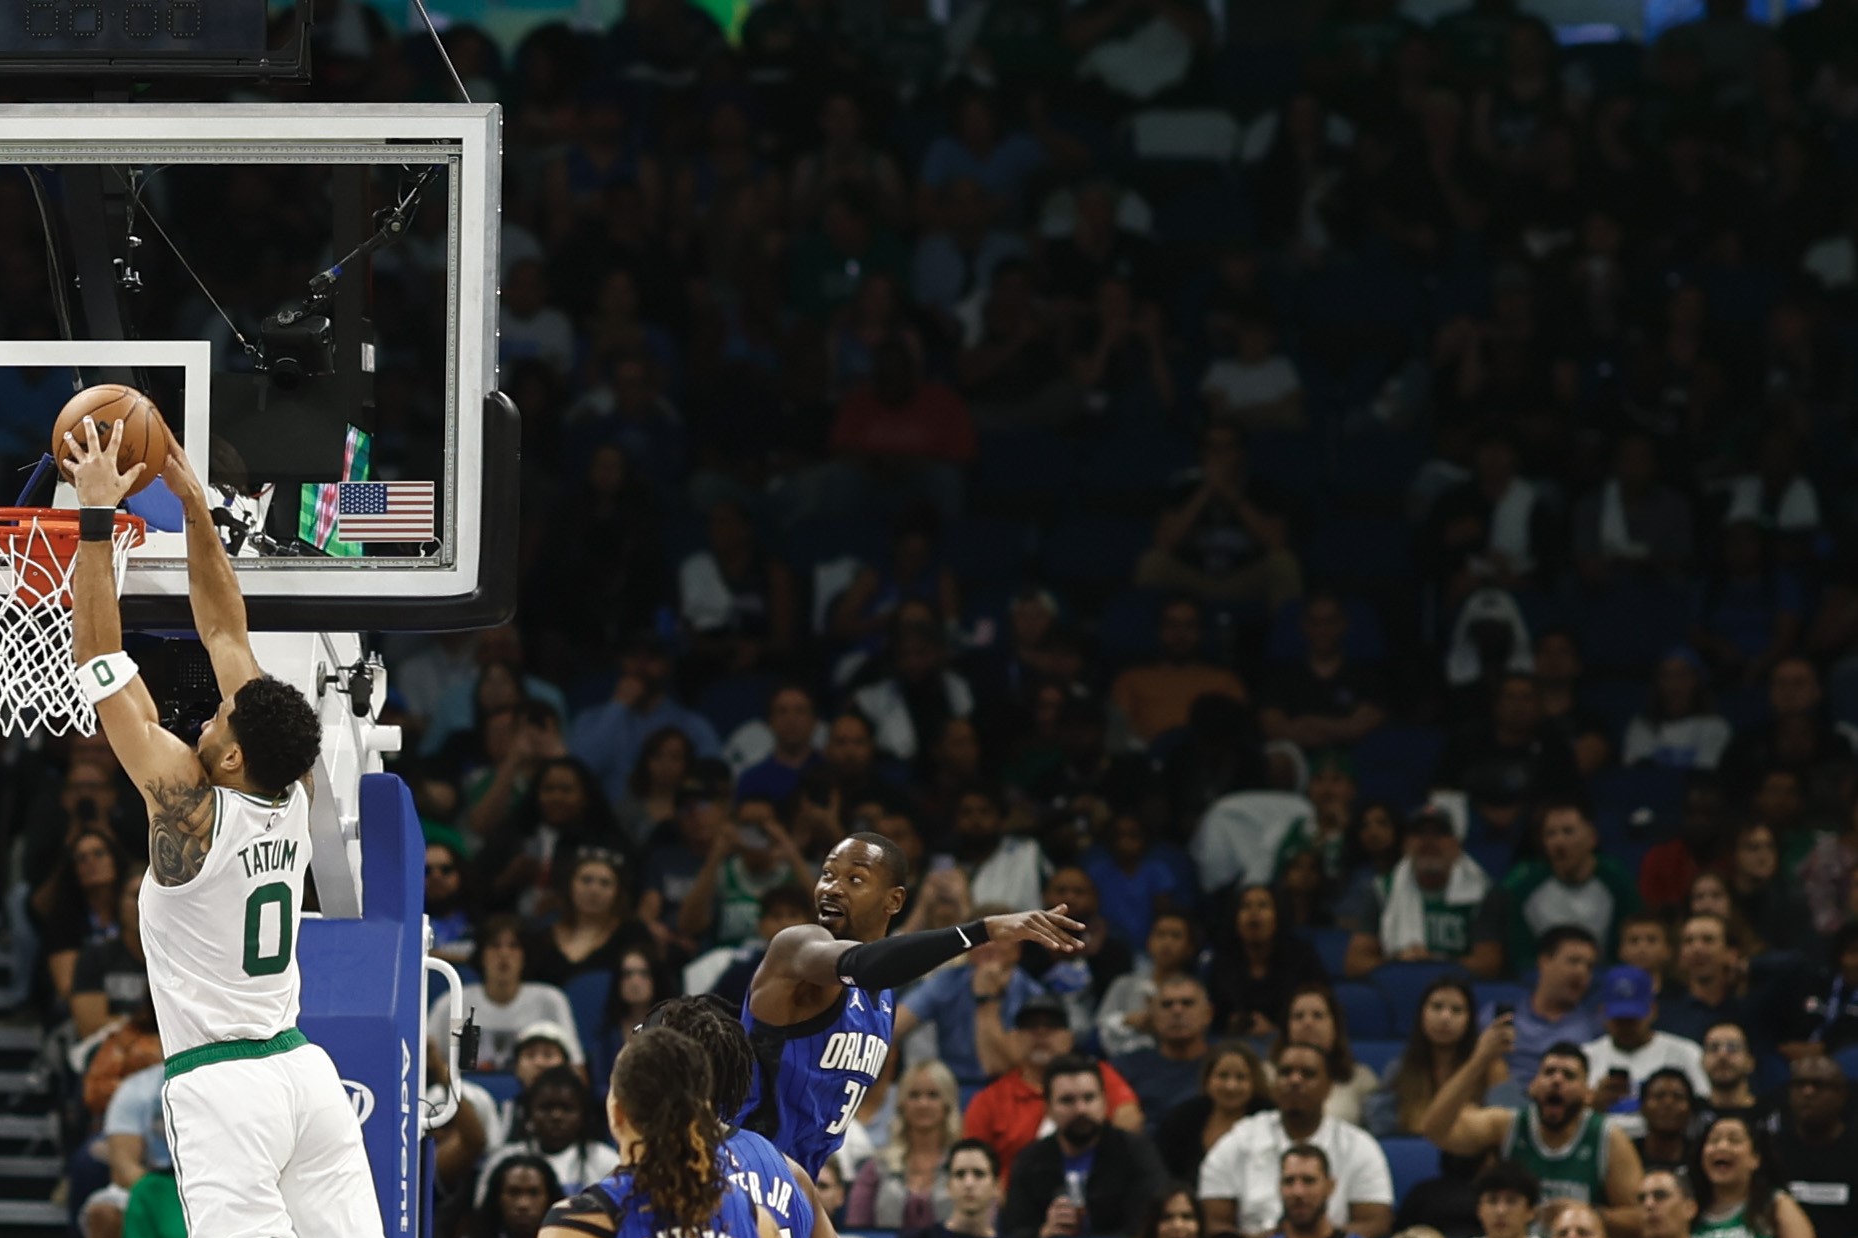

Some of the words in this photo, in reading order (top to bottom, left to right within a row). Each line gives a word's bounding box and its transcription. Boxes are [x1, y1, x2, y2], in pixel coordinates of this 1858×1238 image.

[92, 660, 115, 687] 0
[238, 839, 298, 878] TATUM
[242, 881, 292, 977] 0
[767, 1176, 793, 1219] JR.
